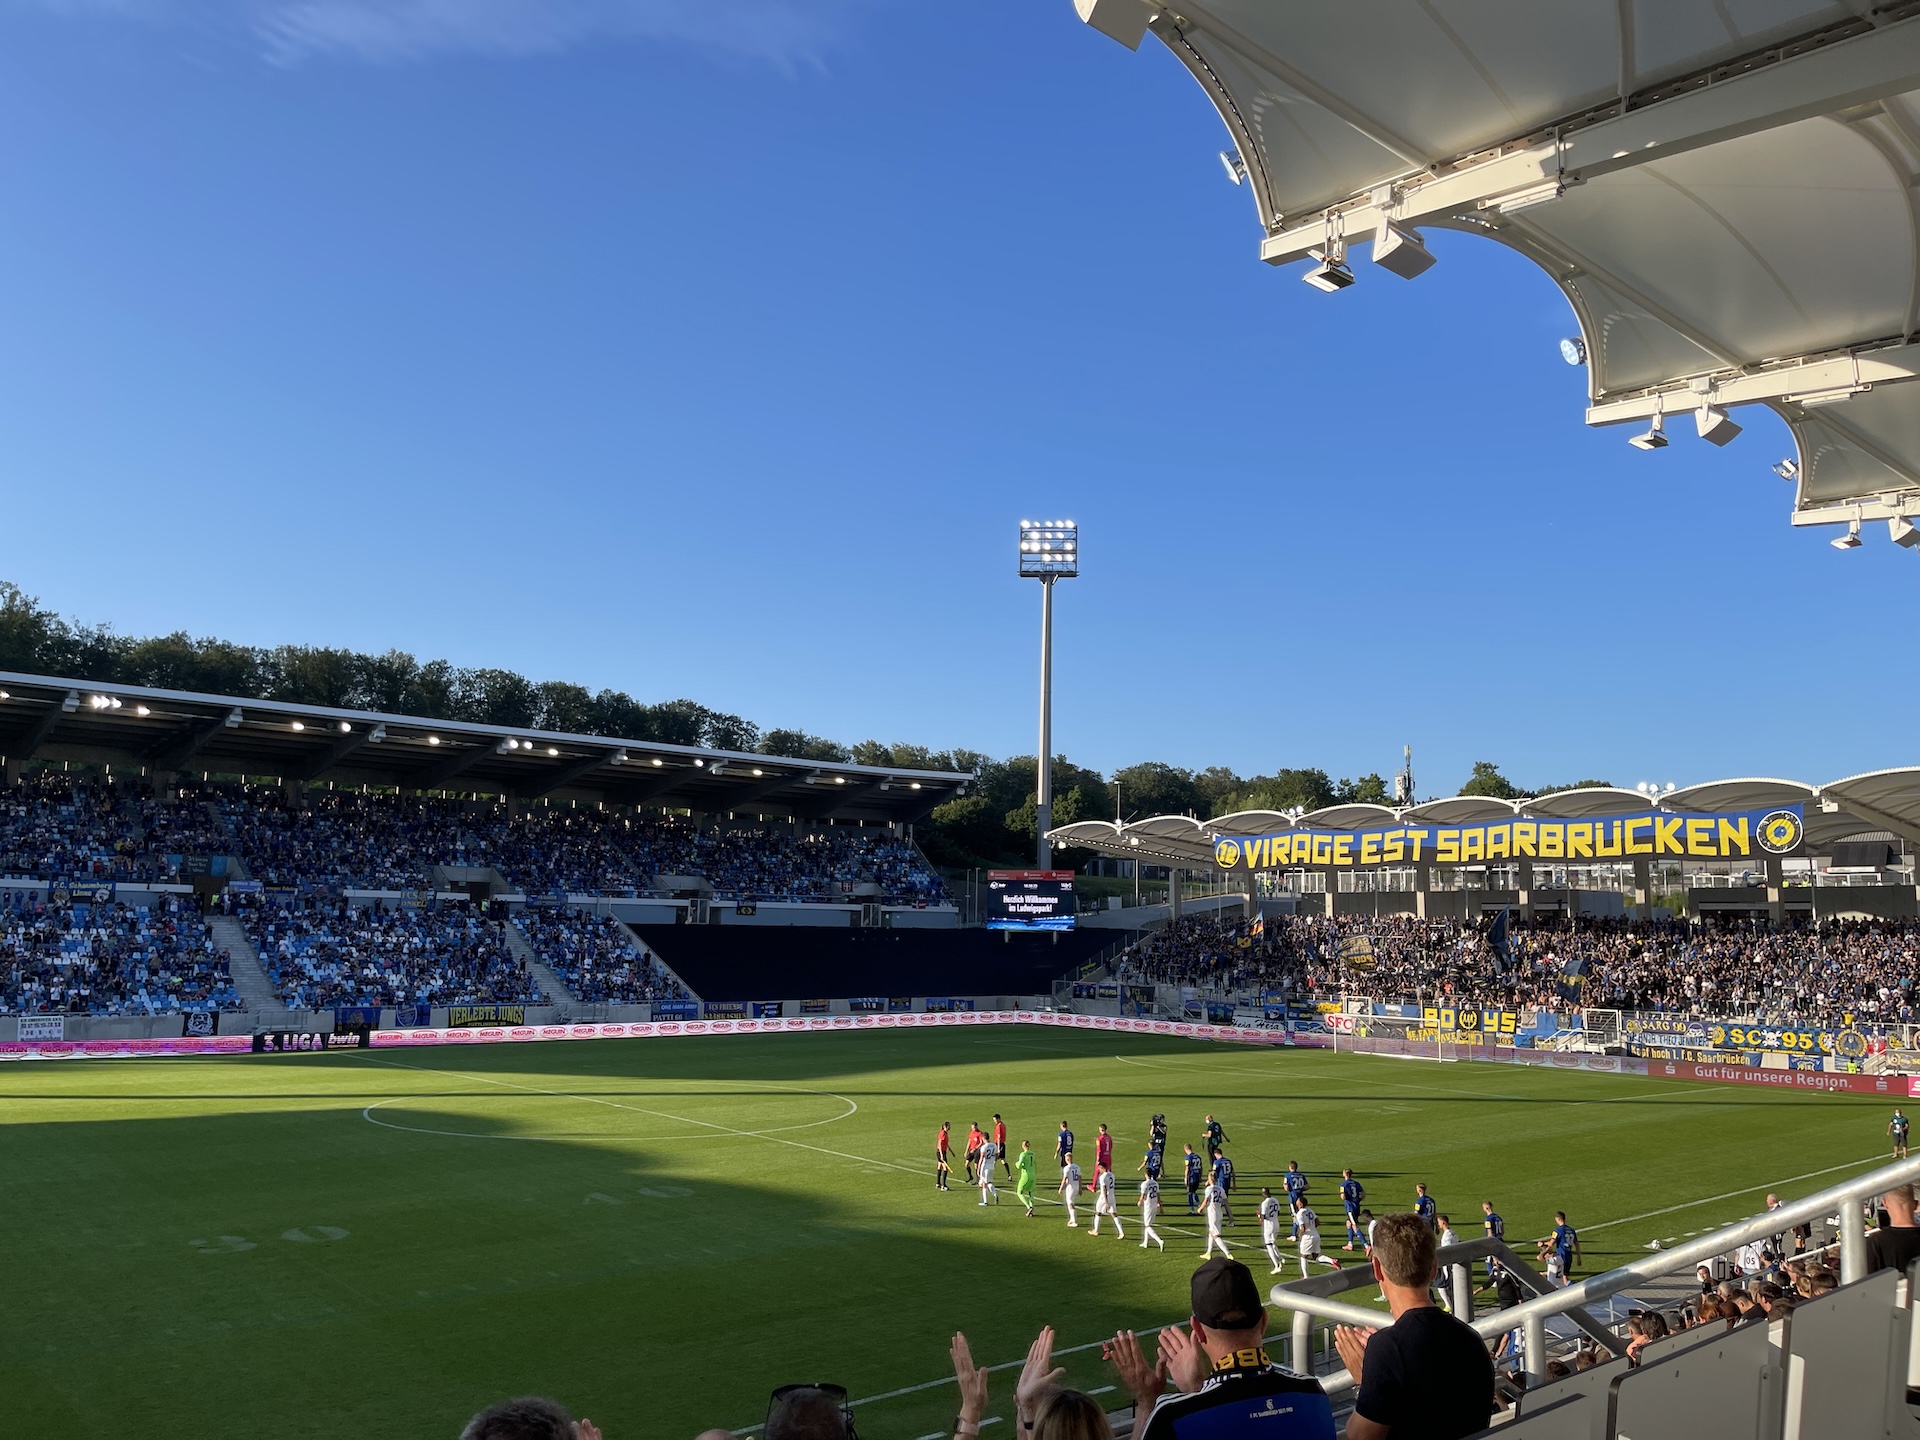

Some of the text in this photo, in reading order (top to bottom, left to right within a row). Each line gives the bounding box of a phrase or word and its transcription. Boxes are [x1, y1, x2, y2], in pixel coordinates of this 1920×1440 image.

[1244, 834, 1354, 868] VIRAGE
[1361, 830, 1428, 864] EST
[1437, 817, 1750, 861] SAARBRÜCKEN
[1003, 895, 1058, 904] Herzlich Willkommen
[450, 1005, 524, 1026] VERLEBTE JUNGS
[1327, 1016, 1354, 1030] SFC
[1642, 1020, 1686, 1032] SARG 99
[263, 1034, 323, 1051] 3. LIGA
[328, 1032, 360, 1044] bwin
[1730, 1028, 1813, 1048] SC 95
[1631, 1045, 1750, 1065] Kopf hoch 1. F.C. Saarbrücken
[1694, 1066, 1852, 1089] Gut für unsere Region.
[1067, 1136, 1072, 1145] 8
[1192, 1159, 1201, 1169] 22
[1222, 1163, 1231, 1174] 13
[1072, 1170, 1079, 1181] 16
[1109, 1177, 1113, 1188] 2
[1292, 1178, 1304, 1189] 20
[1351, 1186, 1356, 1198] 3
